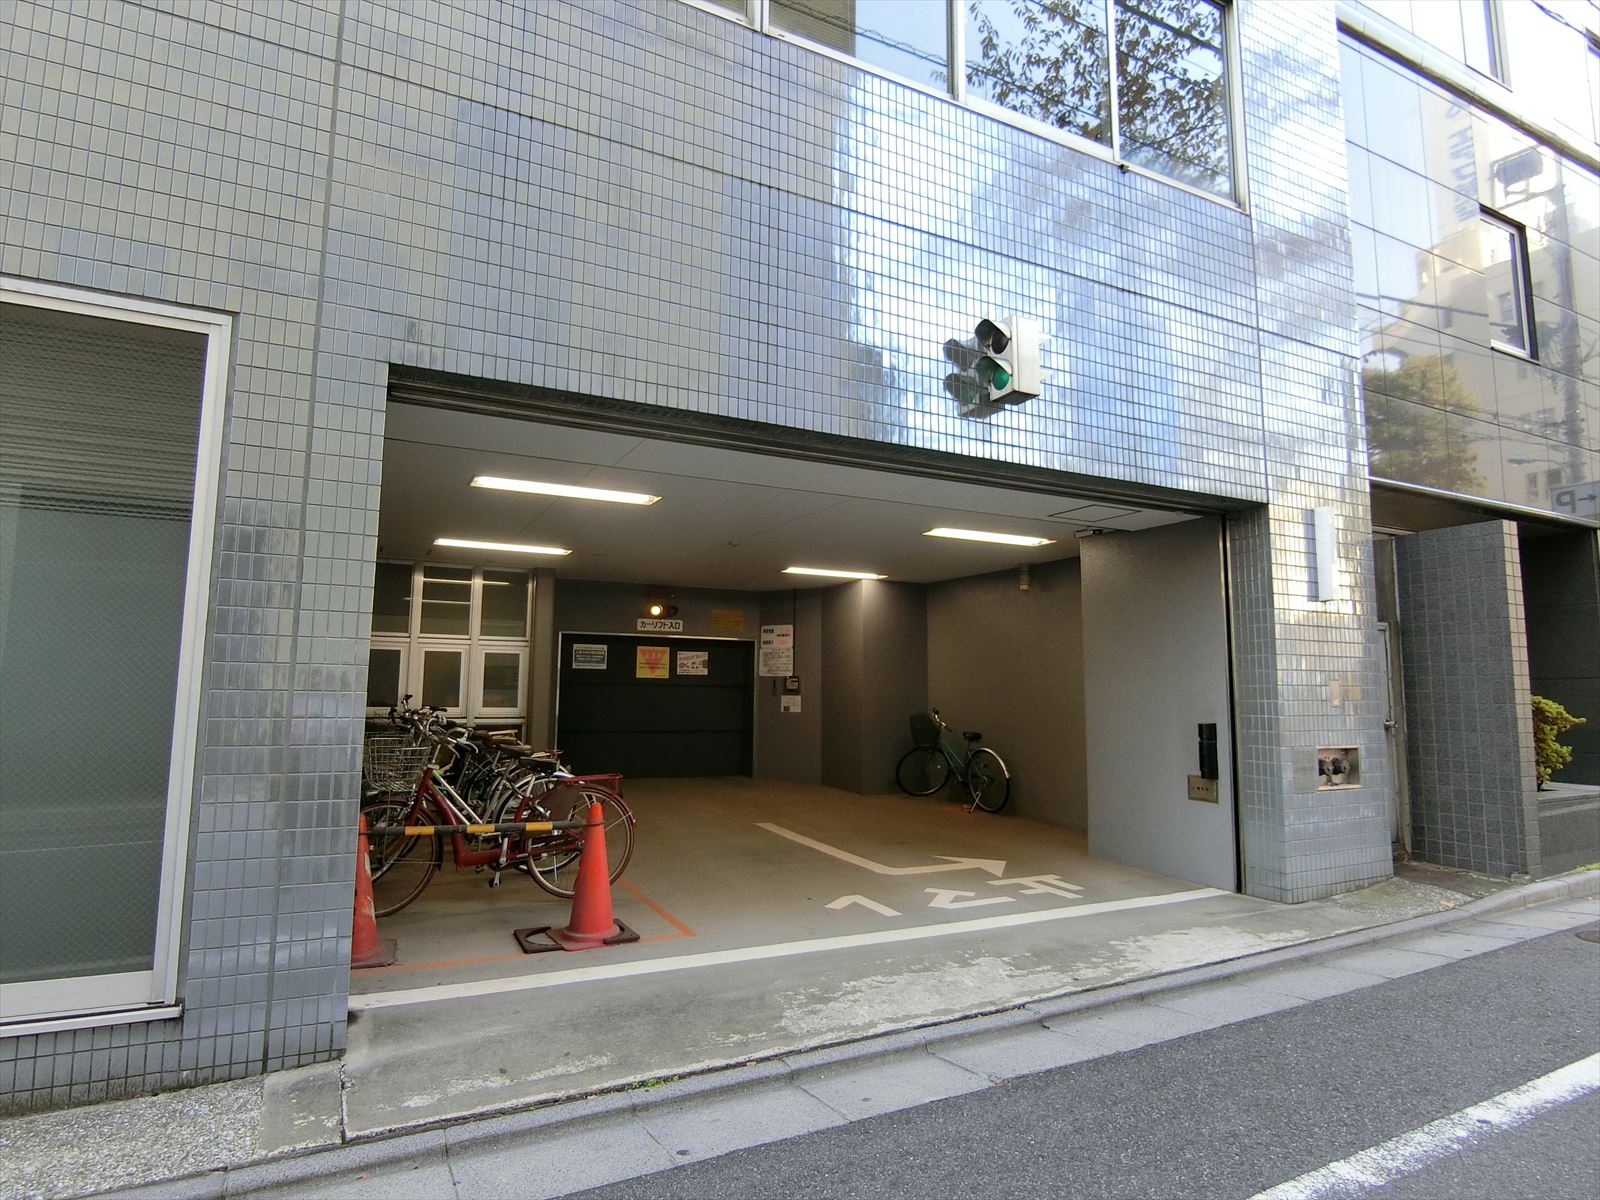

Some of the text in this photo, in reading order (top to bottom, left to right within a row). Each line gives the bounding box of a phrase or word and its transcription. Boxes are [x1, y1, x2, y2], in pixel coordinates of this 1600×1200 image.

[639, 620, 680, 630] カーリフト入口
